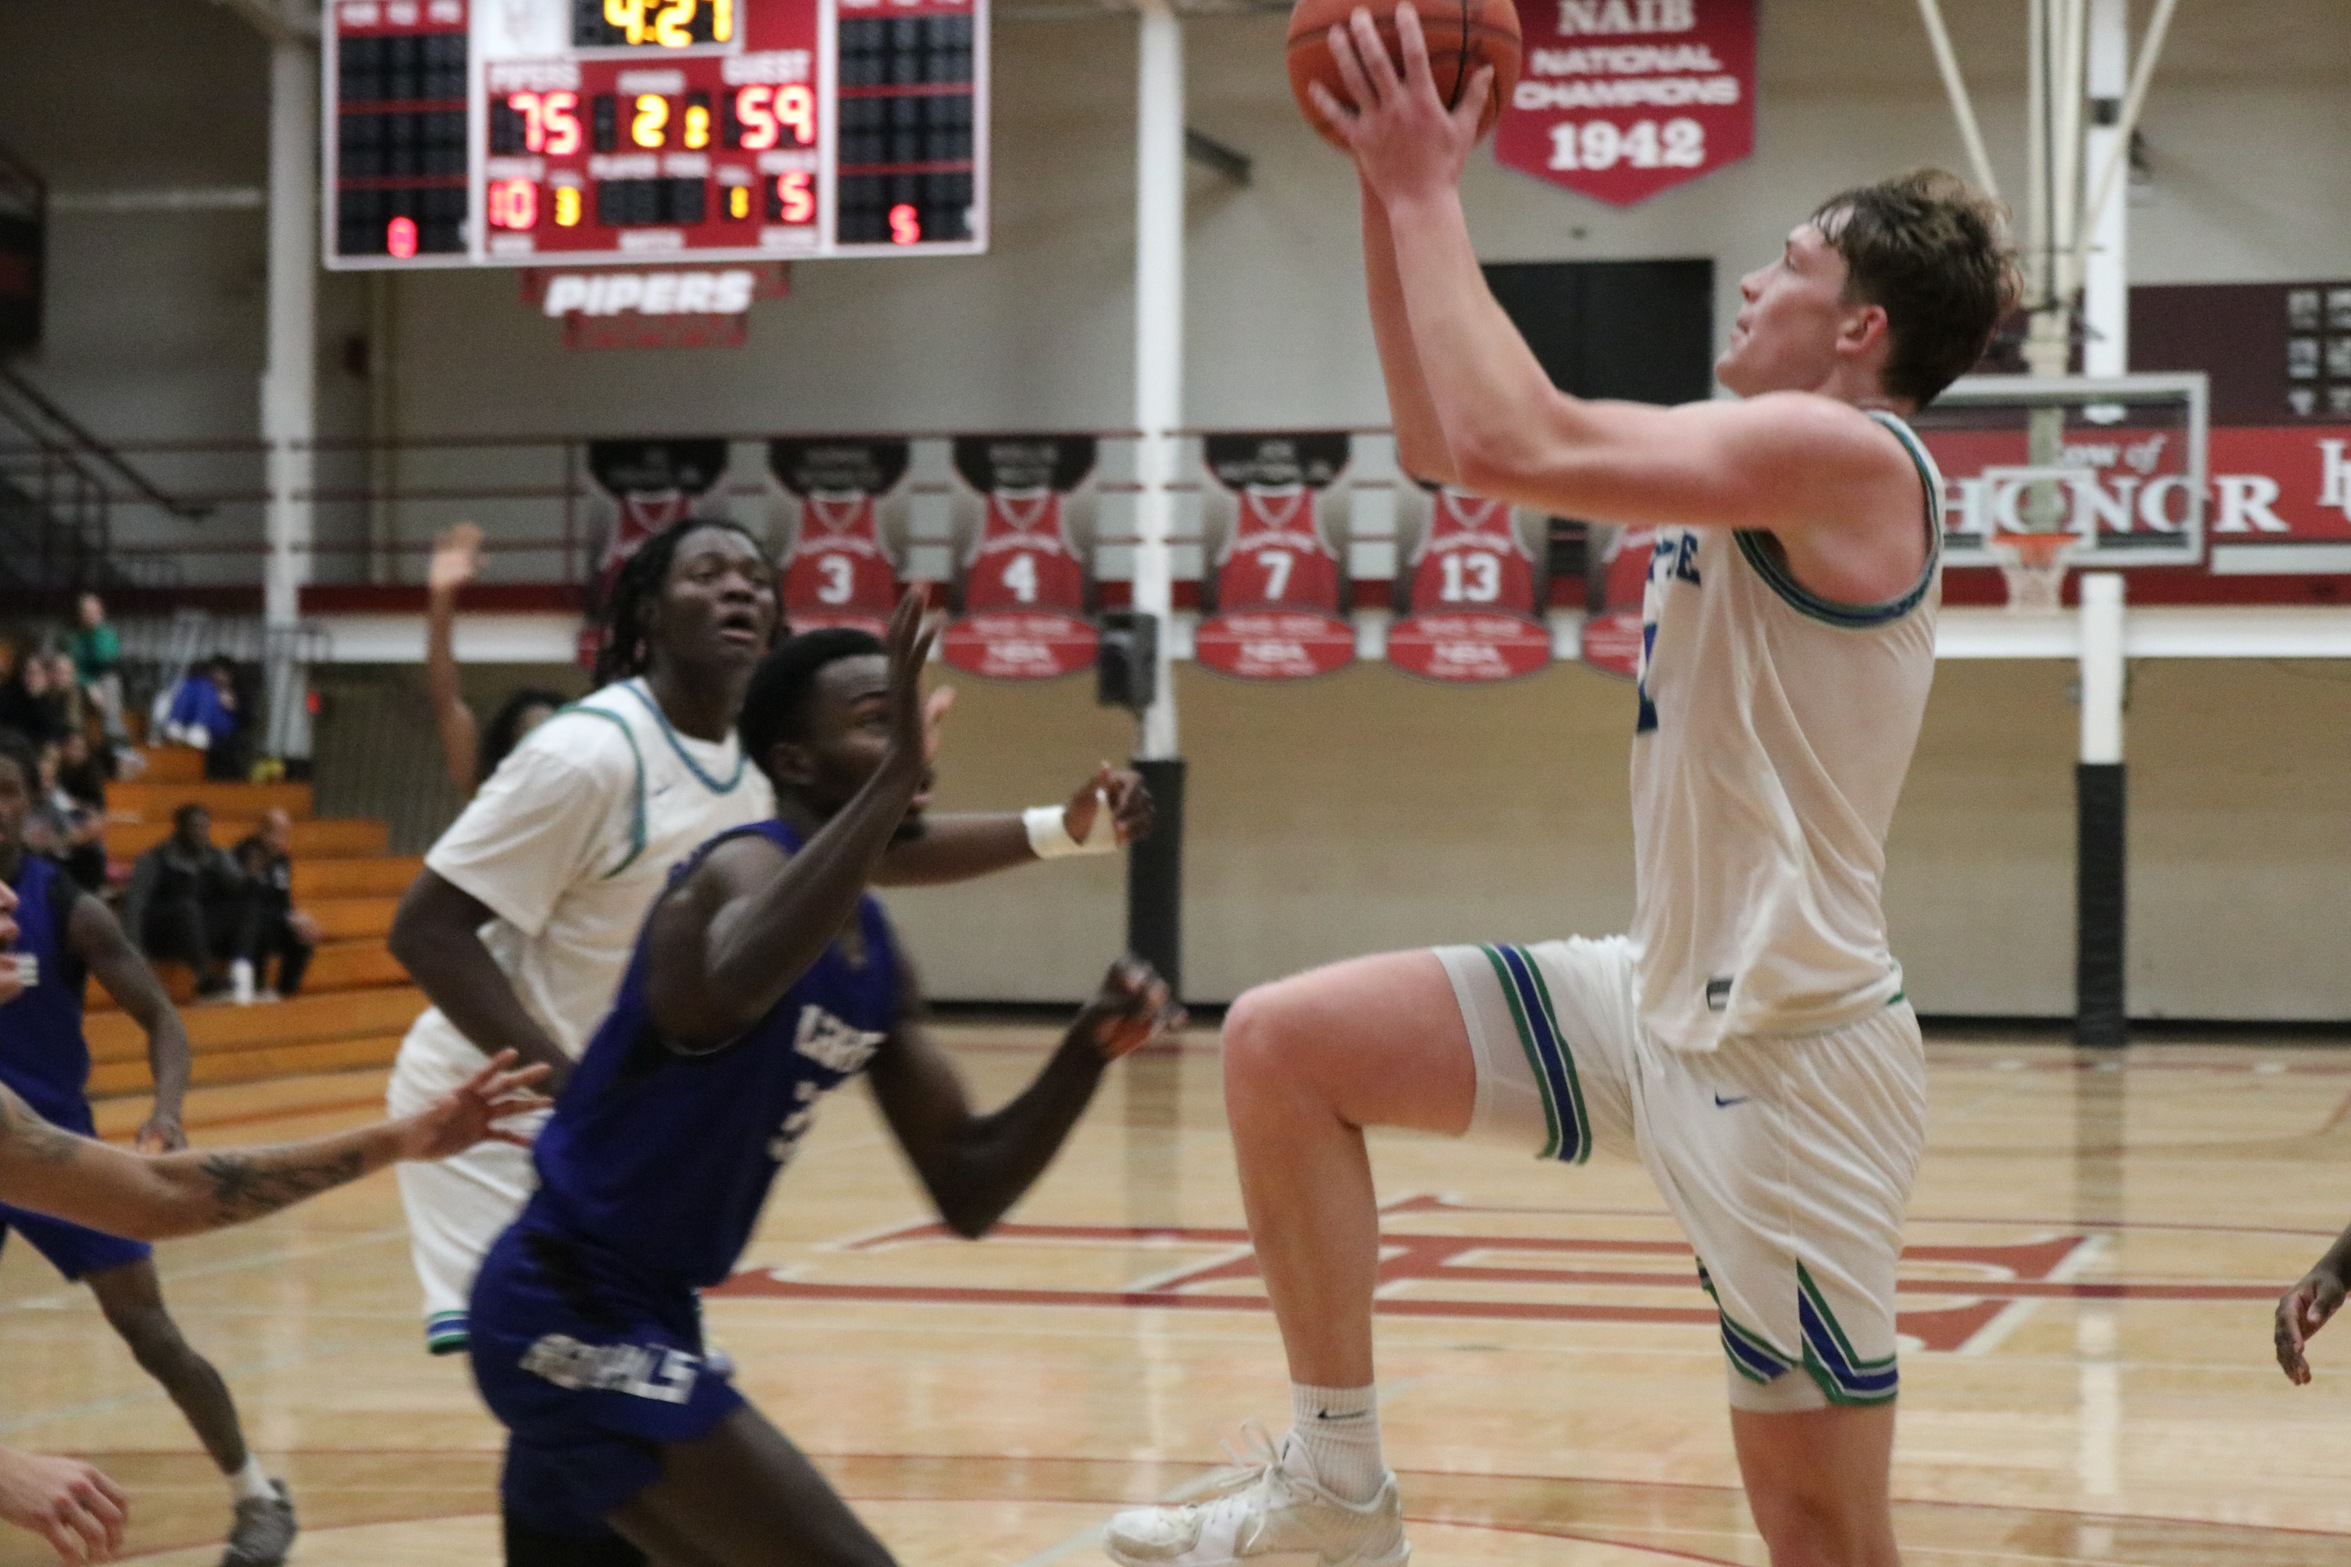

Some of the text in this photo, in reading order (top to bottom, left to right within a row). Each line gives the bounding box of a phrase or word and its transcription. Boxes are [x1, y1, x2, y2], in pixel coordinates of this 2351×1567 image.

[1531, 46, 1722, 75] NATIONAL
[736, 83, 817, 149] 59
[1514, 77, 1739, 109] CHAMPIONS
[508, 89, 582, 155] 75
[632, 93, 669, 148] 2
[1549, 118, 1704, 170] 1942
[489, 175, 538, 231] 10
[777, 168, 815, 223] 5
[888, 203, 921, 246] 5
[544, 269, 754, 317] PIPERS
[2125, 432, 2169, 475] of
[1942, 477, 2290, 533] HONOR
[818, 555, 853, 603] 3
[1003, 554, 1037, 602] 4
[1258, 552, 1293, 600] 7
[1441, 554, 1500, 601] 13
